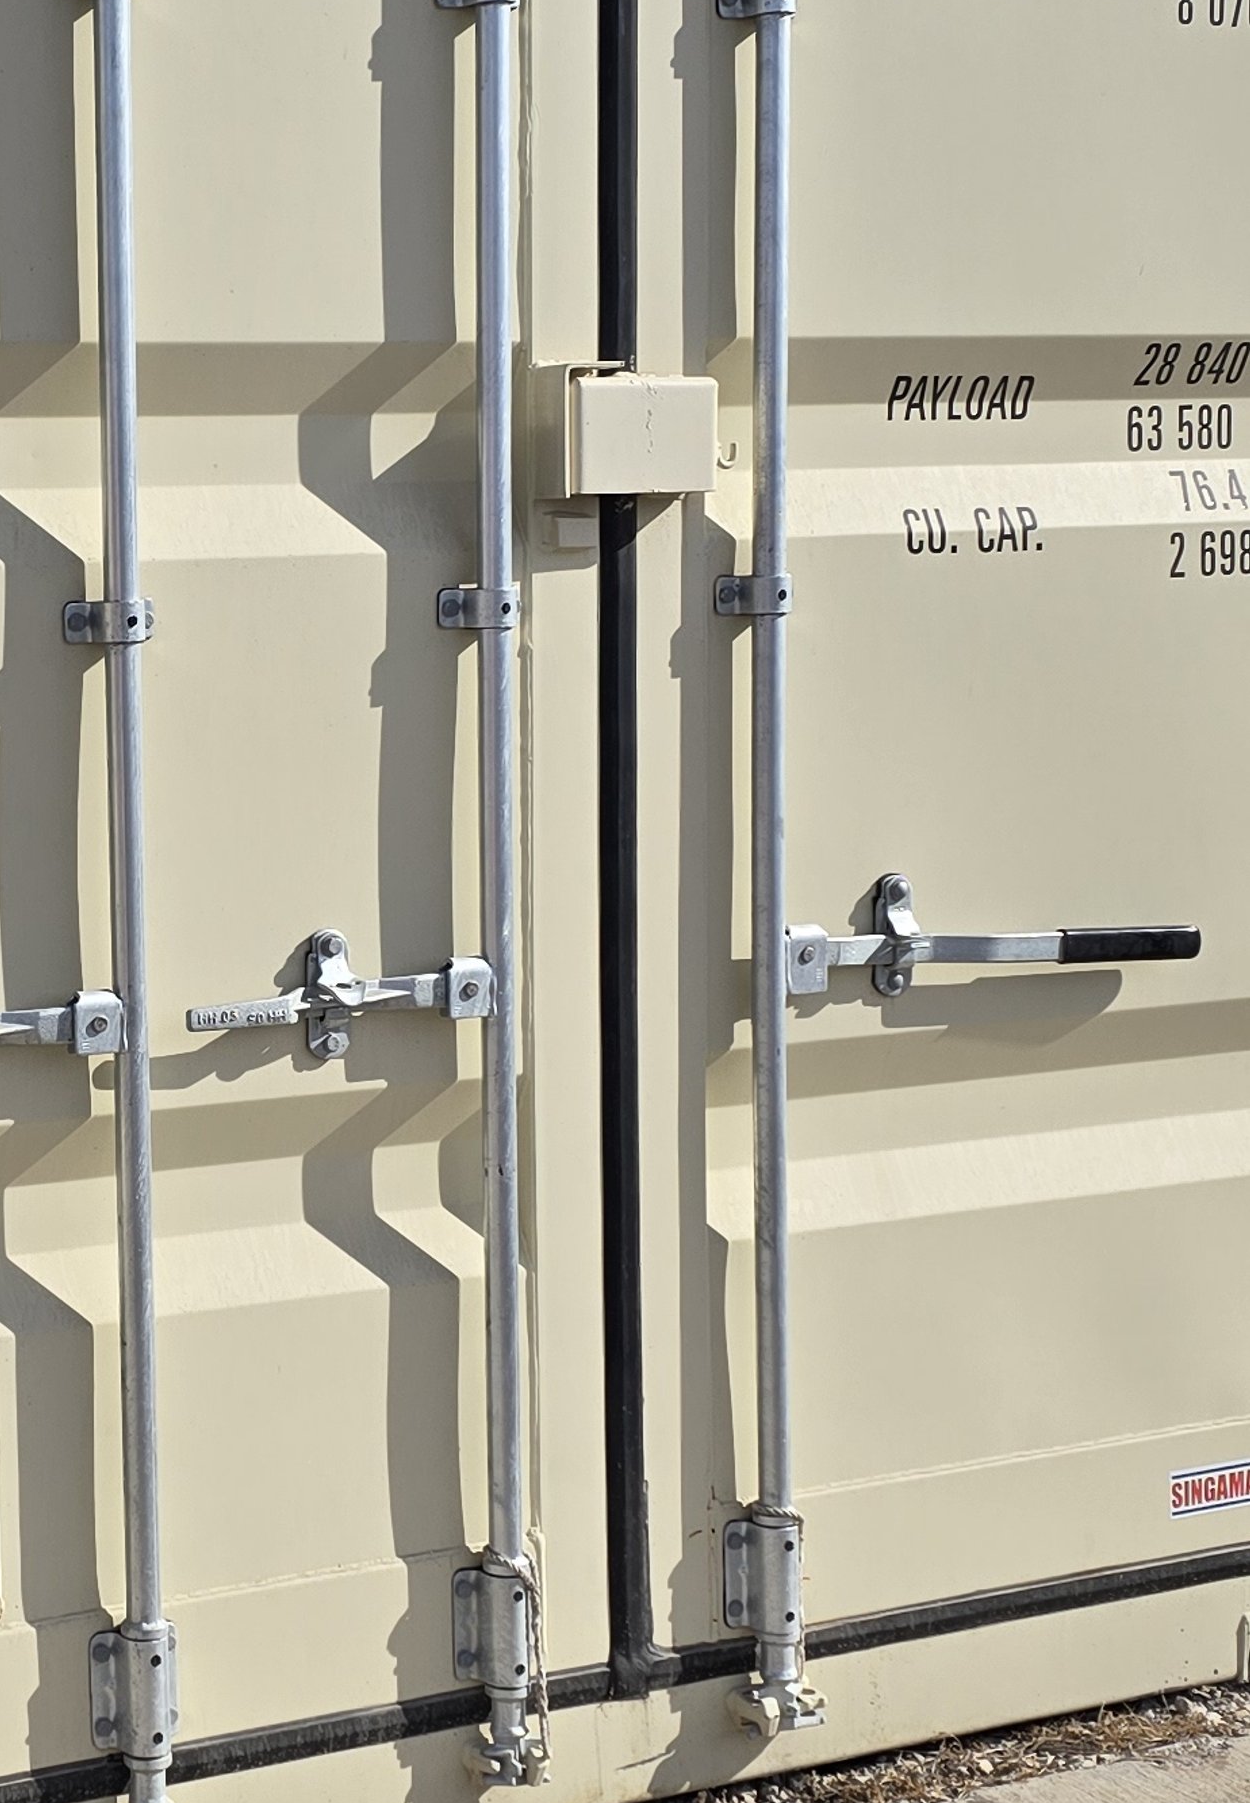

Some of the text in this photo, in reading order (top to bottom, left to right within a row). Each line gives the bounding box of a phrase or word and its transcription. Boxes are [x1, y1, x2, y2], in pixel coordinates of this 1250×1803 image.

[1133, 341, 1250, 386] 28 840
[886, 376, 1035, 421] PAYLOAD
[1127, 403, 1232, 452] 63 580
[1168, 469, 1249, 512] 76.4
[902, 506, 1044, 555] CU. CAP.
[1170, 529, 1250, 578] 2 698
